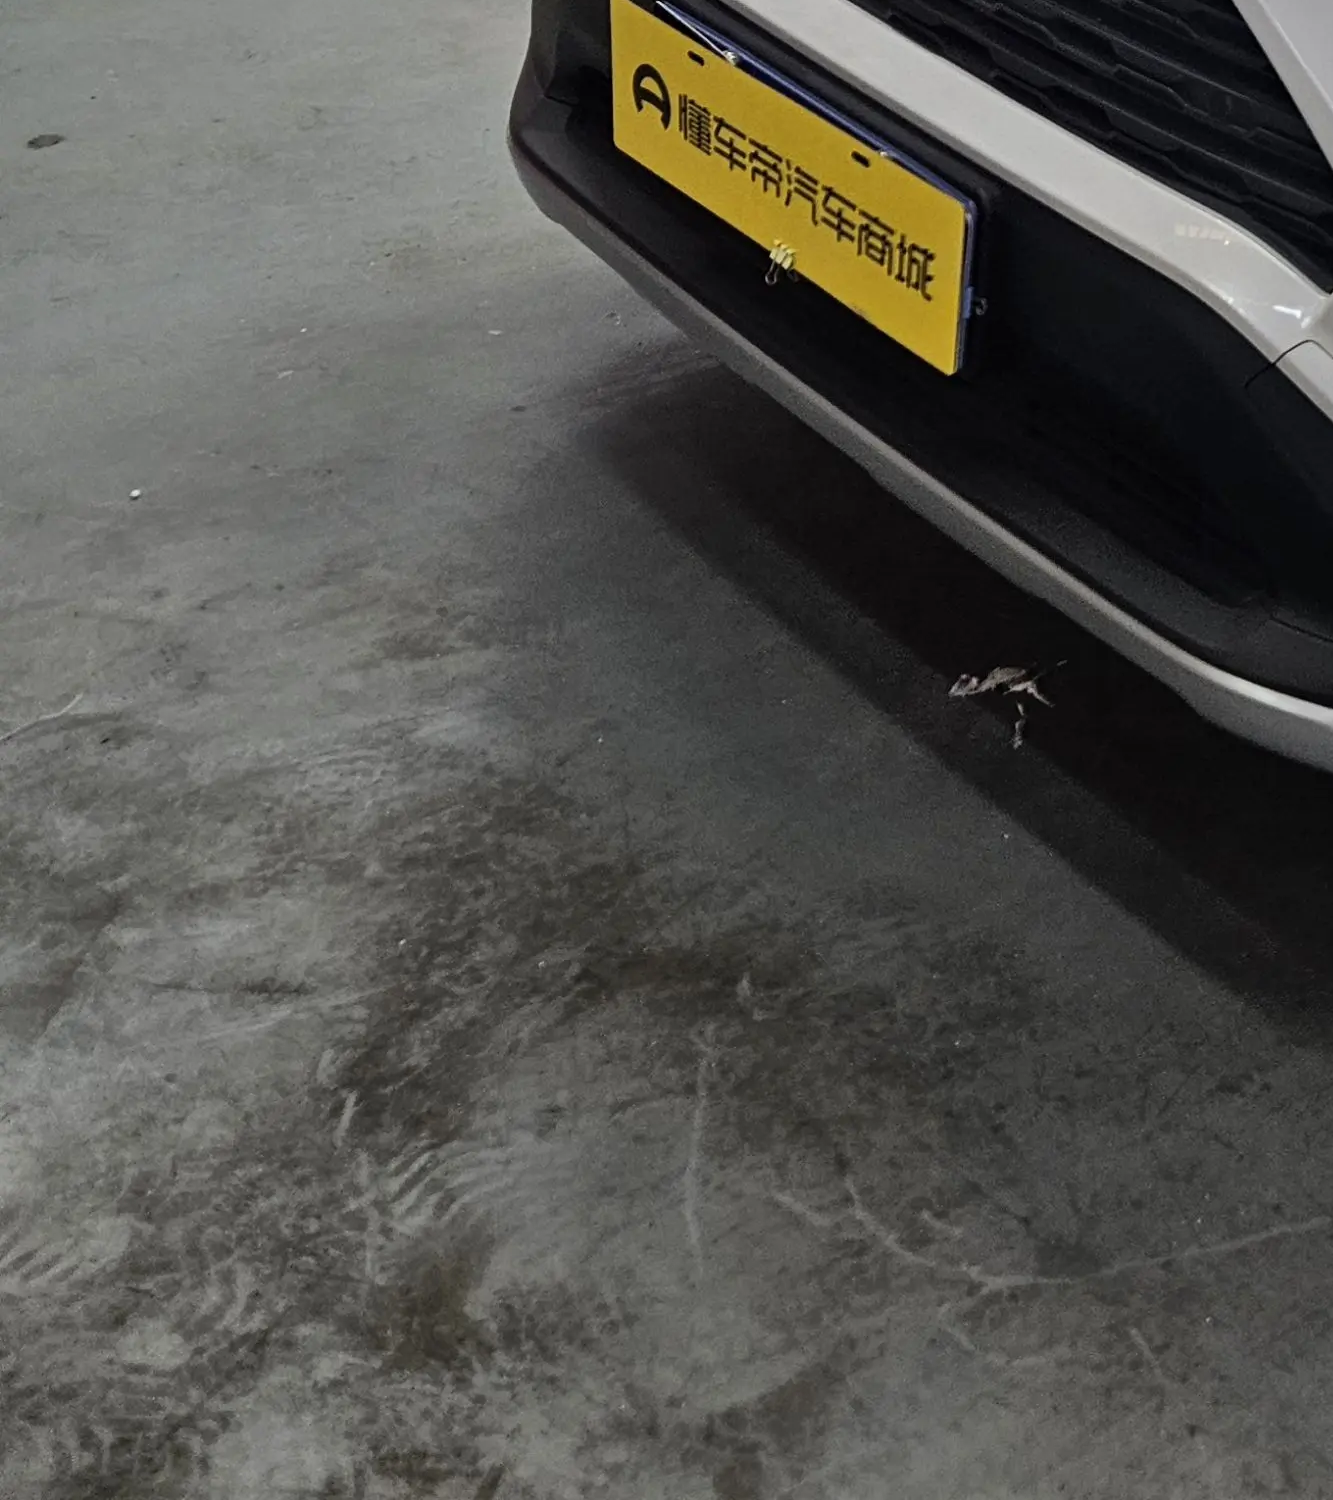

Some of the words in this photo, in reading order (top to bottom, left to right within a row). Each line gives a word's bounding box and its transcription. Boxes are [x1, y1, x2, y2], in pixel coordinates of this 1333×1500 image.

[678, 93, 936, 302] 懂车帝汽车商城
